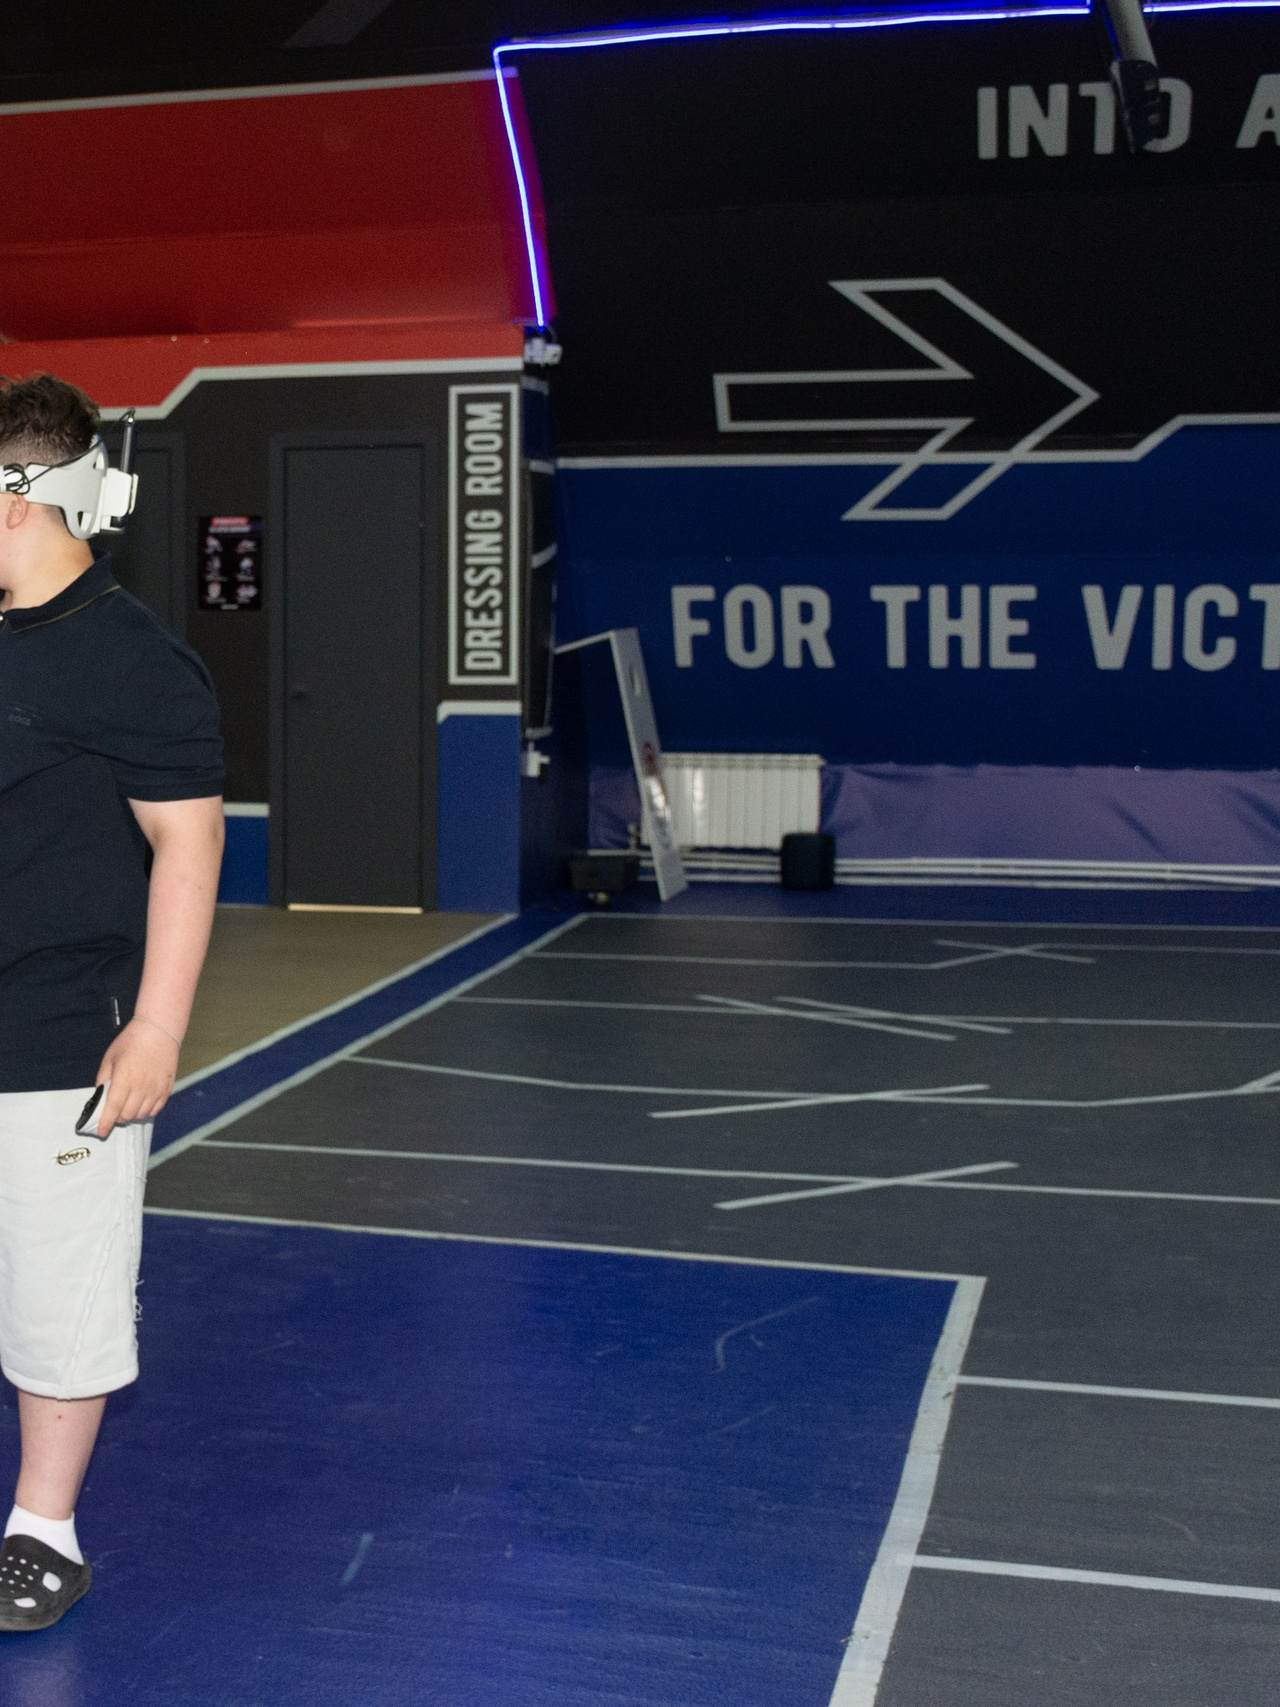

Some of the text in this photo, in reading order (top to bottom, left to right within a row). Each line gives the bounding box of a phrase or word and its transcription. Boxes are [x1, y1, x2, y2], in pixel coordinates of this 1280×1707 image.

[977, 77, 1193, 160] INTO
[464, 402, 504, 671] DRESSING ROOM
[671, 583, 1280, 672] FOR THE VICT
